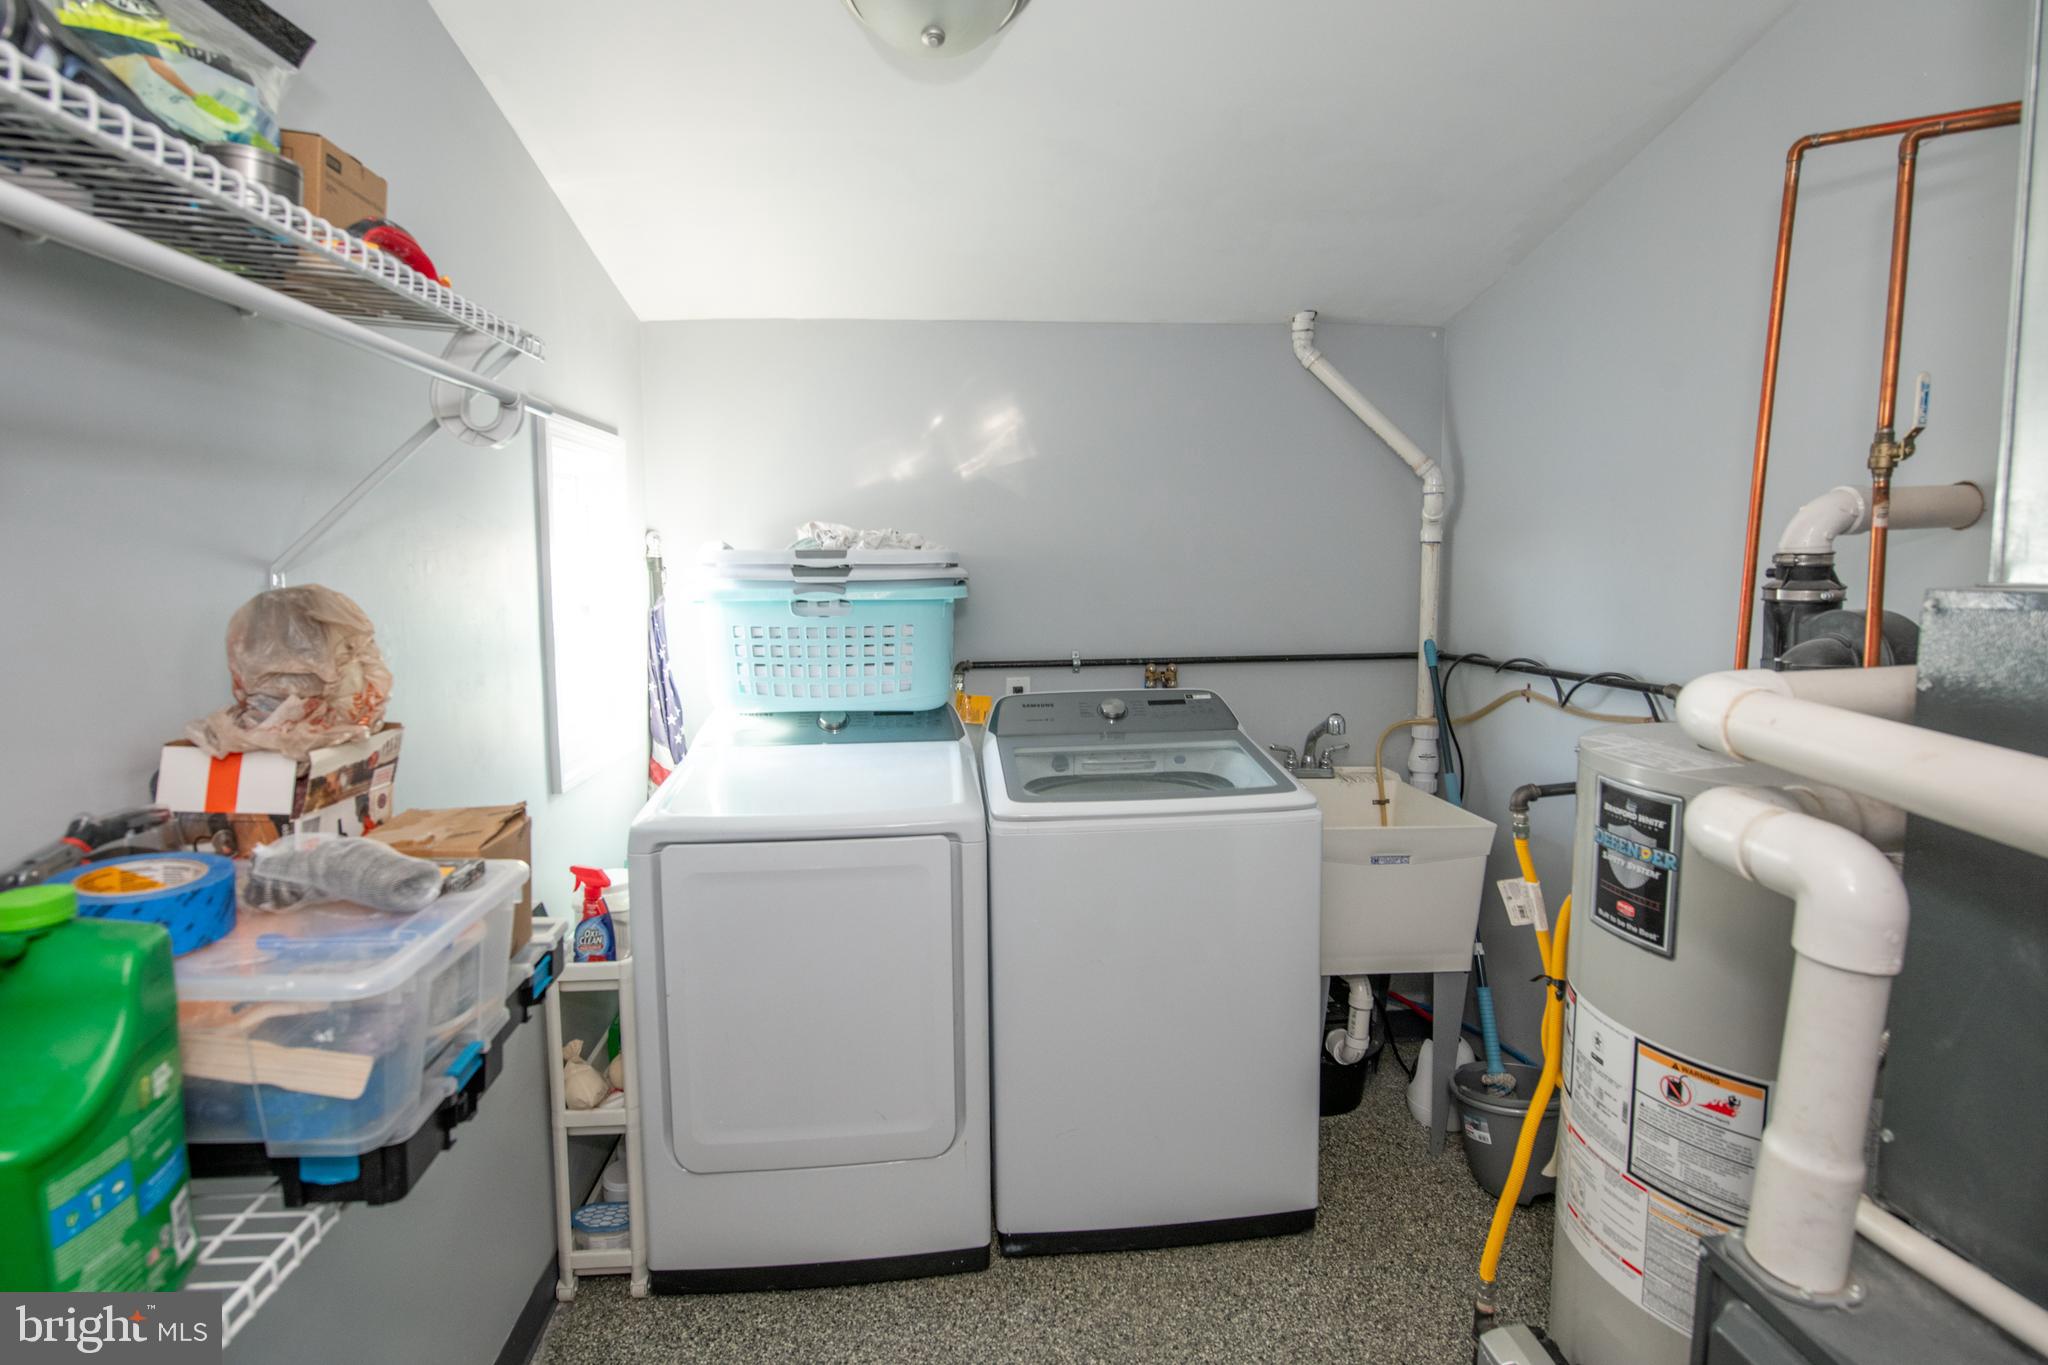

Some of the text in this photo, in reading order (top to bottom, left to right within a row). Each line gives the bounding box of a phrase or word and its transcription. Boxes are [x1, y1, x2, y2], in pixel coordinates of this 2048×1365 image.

[1596, 826, 1678, 872] DEFENDER
[579, 935, 603, 945] CLEAN
[1681, 1067, 1720, 1085] WARNING
